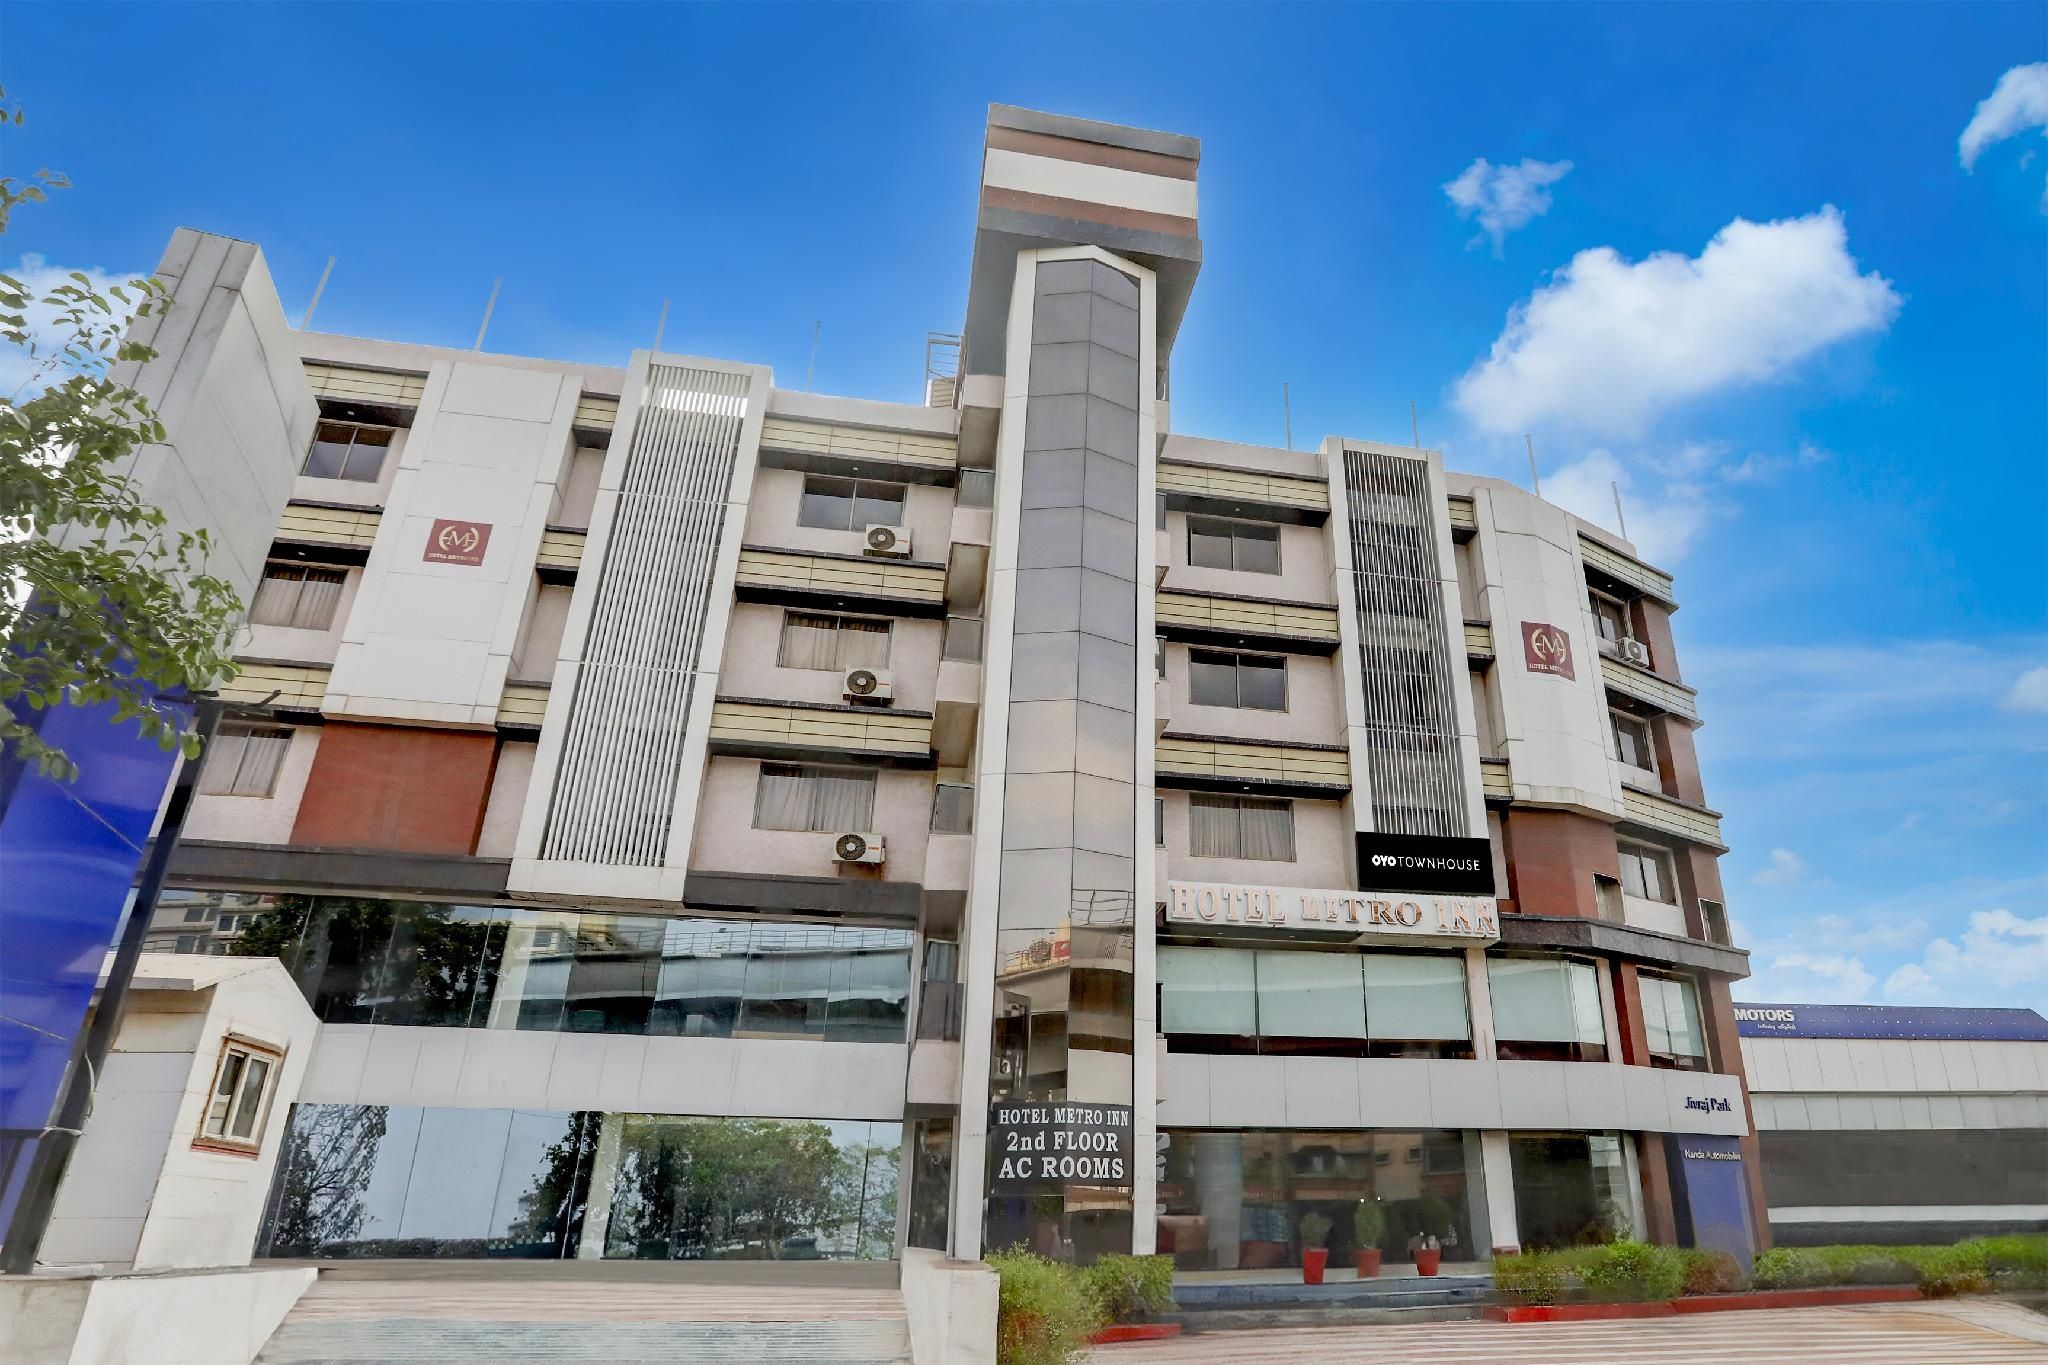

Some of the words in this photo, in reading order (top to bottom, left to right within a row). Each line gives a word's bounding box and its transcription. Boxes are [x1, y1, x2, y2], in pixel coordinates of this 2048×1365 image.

[1371, 854, 1397, 867] OYO
[1397, 856, 1480, 871] TOWNHOUSE
[1171, 881, 1287, 924] HOTEL
[1301, 895, 1423, 926] METRO
[1434, 896, 1496, 935] INN
[1733, 1008, 1795, 1022] MOTORS
[999, 1108, 1050, 1125] HOTEL
[1054, 1107, 1103, 1125] METRO
[1106, 1110, 1129, 1127] INN
[1006, 1130, 1046, 1152] 2nd
[1053, 1131, 1119, 1152] FLOOR
[998, 1156, 1033, 1179] AC
[1041, 1156, 1125, 1179] ROOMS
